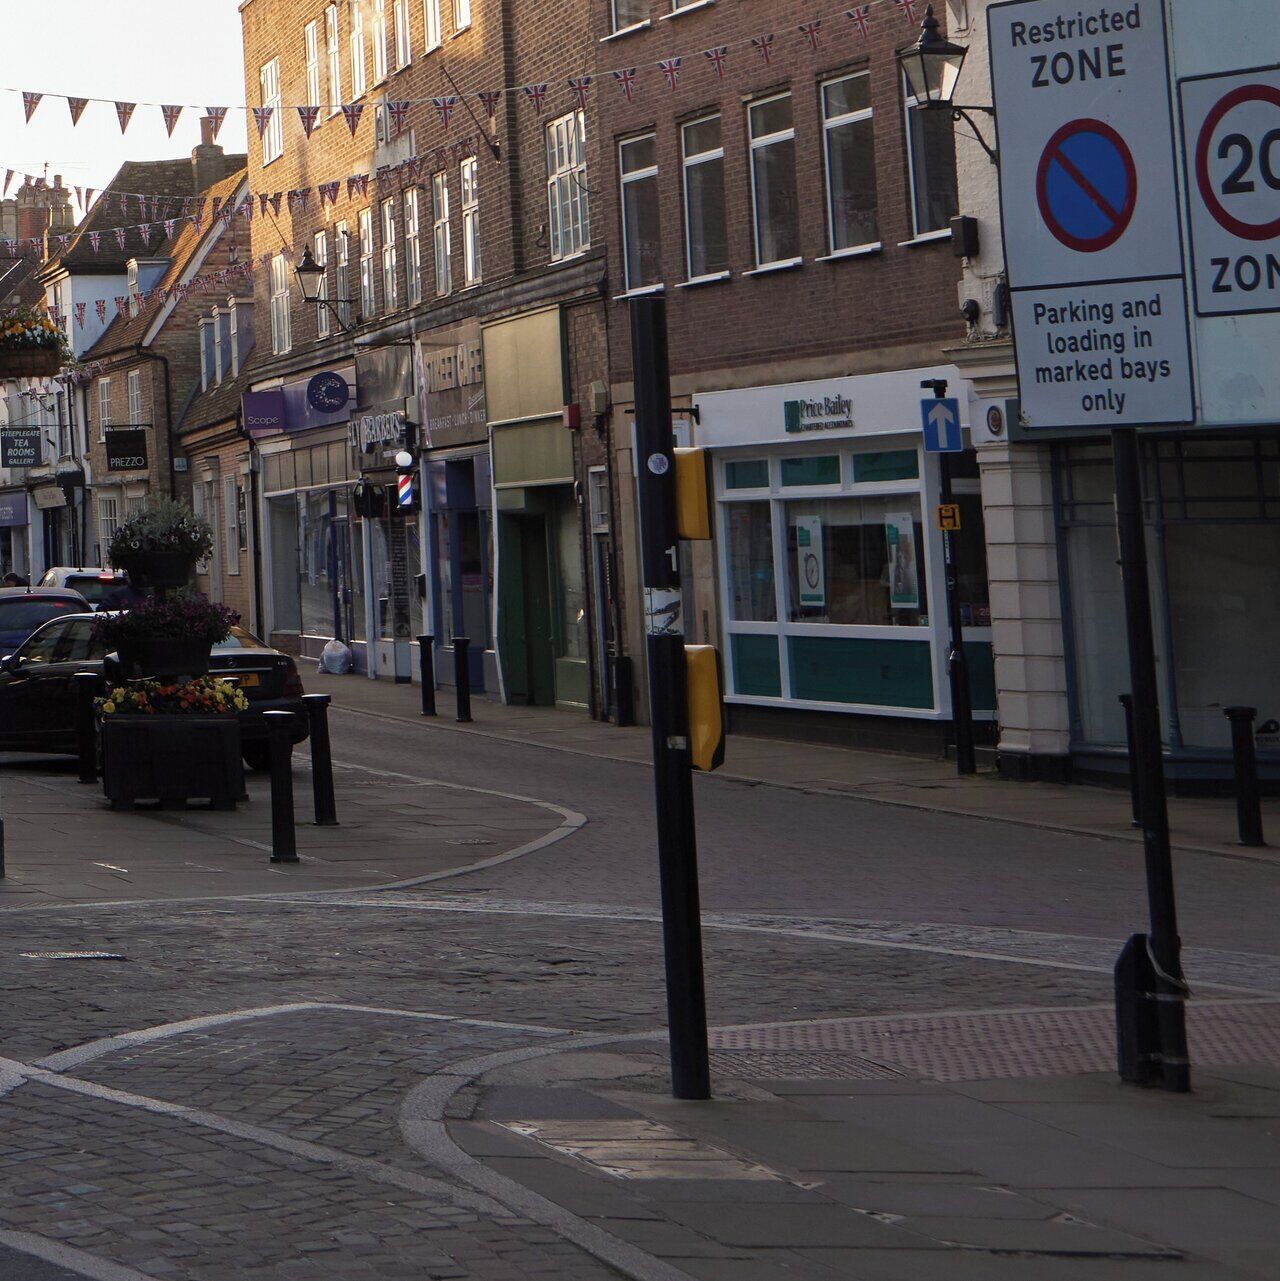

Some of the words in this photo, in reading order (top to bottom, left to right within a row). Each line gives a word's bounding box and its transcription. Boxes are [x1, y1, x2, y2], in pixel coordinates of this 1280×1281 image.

[1010, 4, 1141, 47] Restricted
[1031, 43, 1126, 88] ZONE
[1218, 128, 1280, 195] 20
[1033, 300, 1114, 326] Parking
[1122, 294, 1162, 318] and
[1047, 328, 1125, 355] loading
[1134, 326, 1152, 348] in
[1035, 356, 1114, 384] marked
[1120, 355, 1171, 382] bays
[800, 398, 823, 418] Price
[824, 394, 852, 418] Bailey
[1081, 388, 1126, 415] only
[248, 416, 279, 426] Scope
[7, 448, 35, 456] ROOMS
[14, 439, 29, 447] TEA
[110, 457, 145, 467] PREZZO
